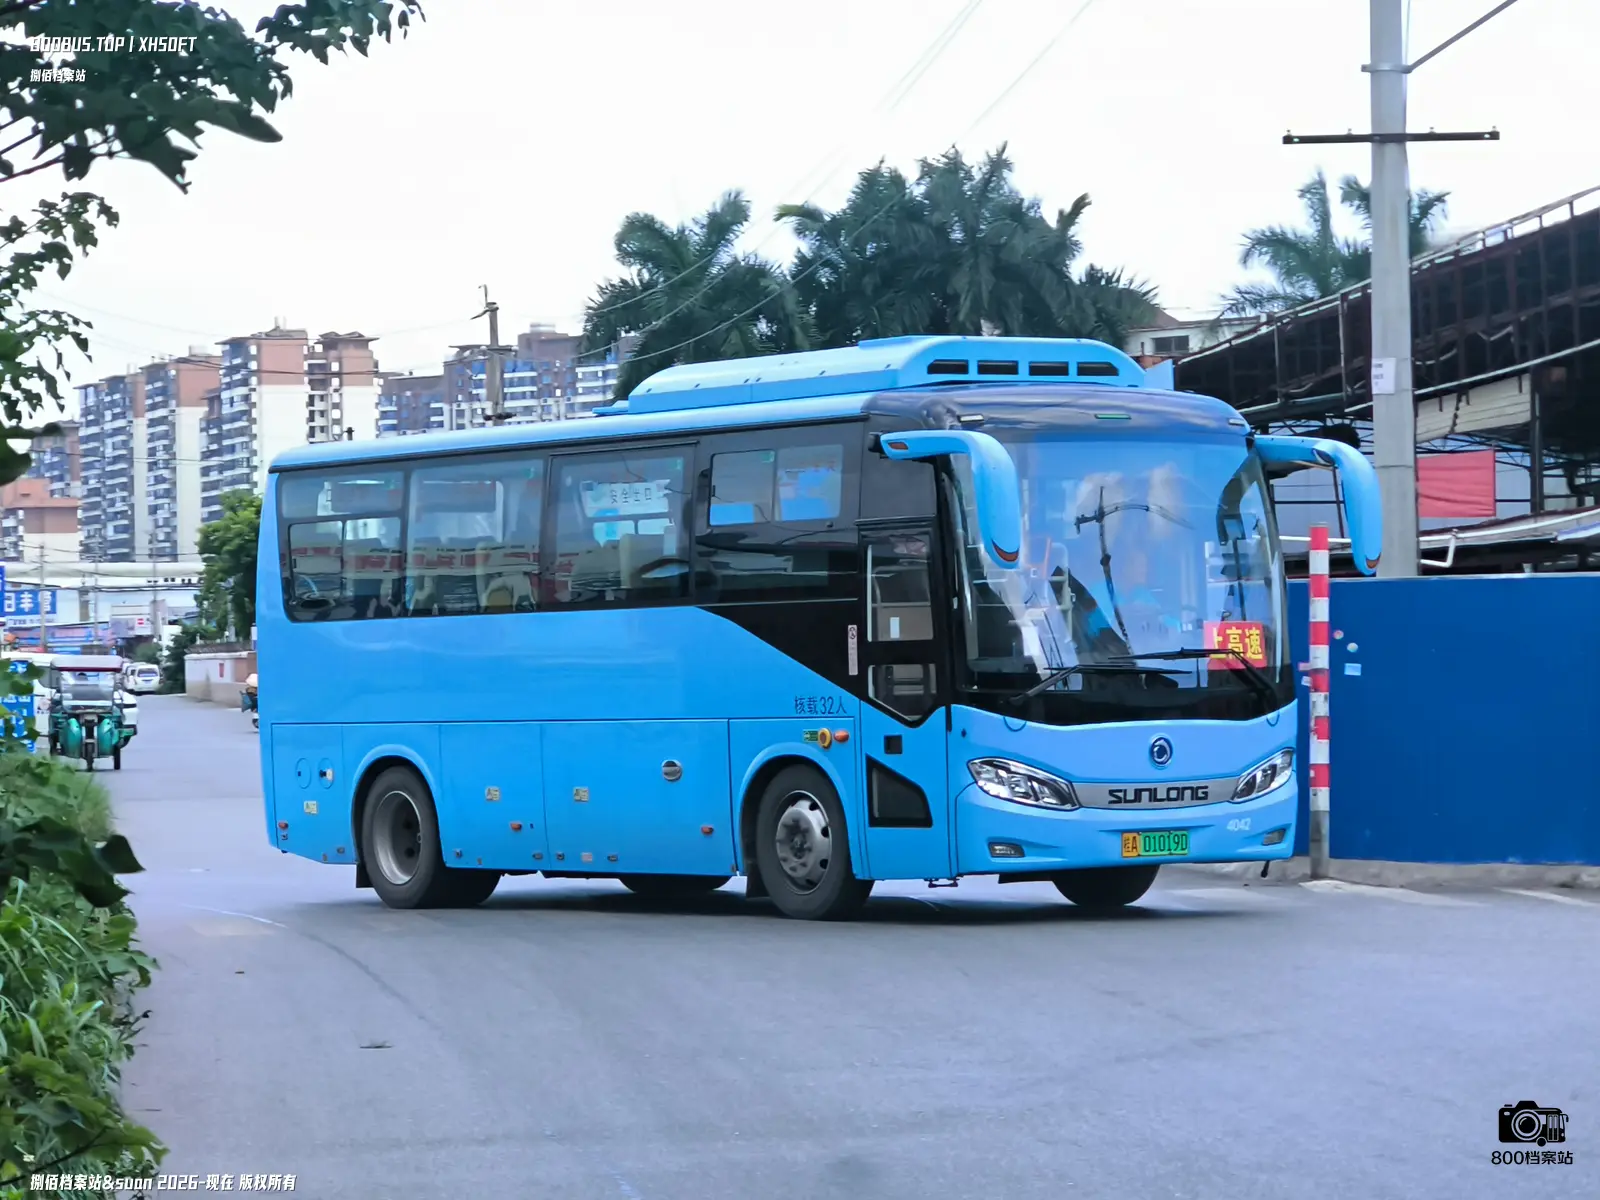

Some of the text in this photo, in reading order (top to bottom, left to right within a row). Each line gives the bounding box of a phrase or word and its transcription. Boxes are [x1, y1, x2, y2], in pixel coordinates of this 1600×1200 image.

[1210, 626, 1263, 659] 上高速
[794, 696, 847, 715] 核载32人
[1108, 786, 1209, 804] SUNLONG
